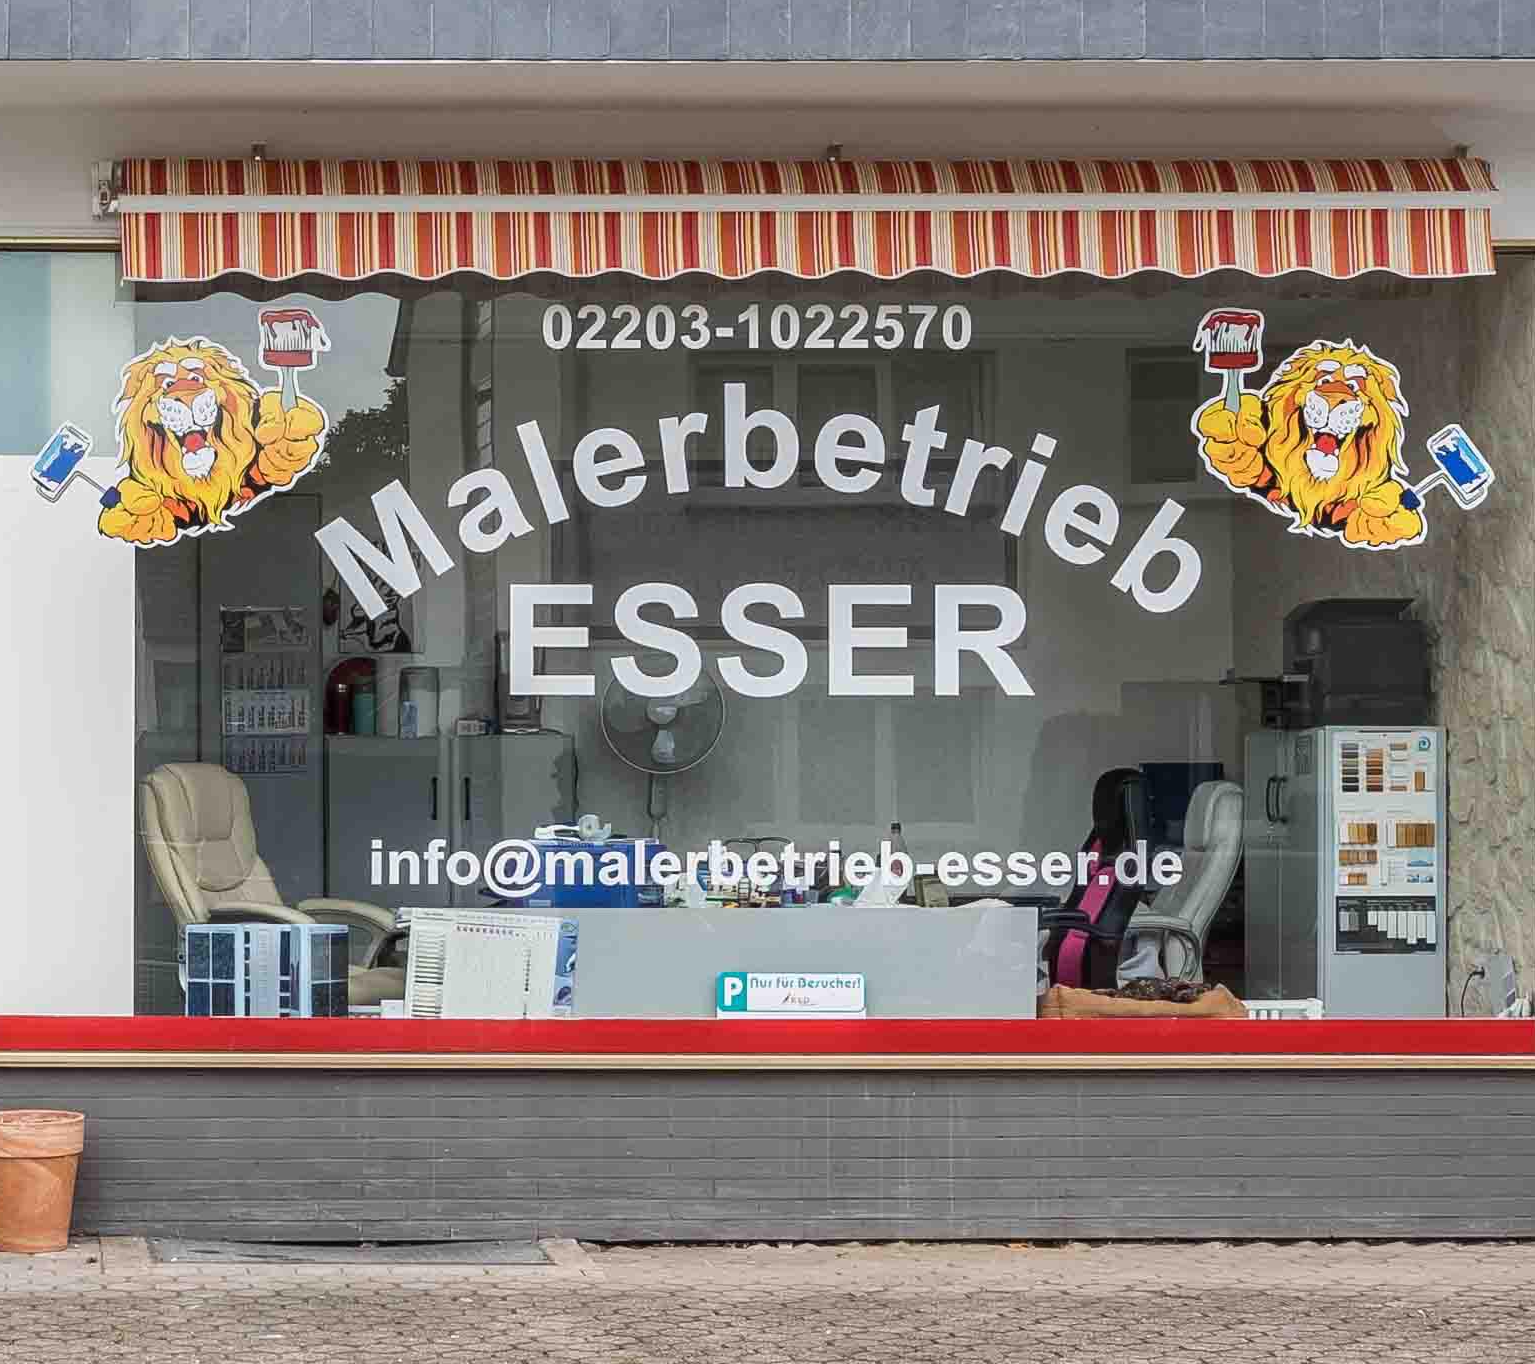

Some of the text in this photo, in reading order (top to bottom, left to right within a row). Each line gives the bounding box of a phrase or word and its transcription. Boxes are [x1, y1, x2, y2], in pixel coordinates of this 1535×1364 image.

[542, 304, 972, 351] 02203-1022570
[315, 383, 1202, 620] Malerbetrieb
[510, 583, 1035, 698] ESSER
[370, 839, 1183, 898] info@malerbetrieb-esser.de
[724, 977, 743, 1007] P
[750, 977, 861, 989] Nur für Besucher!
